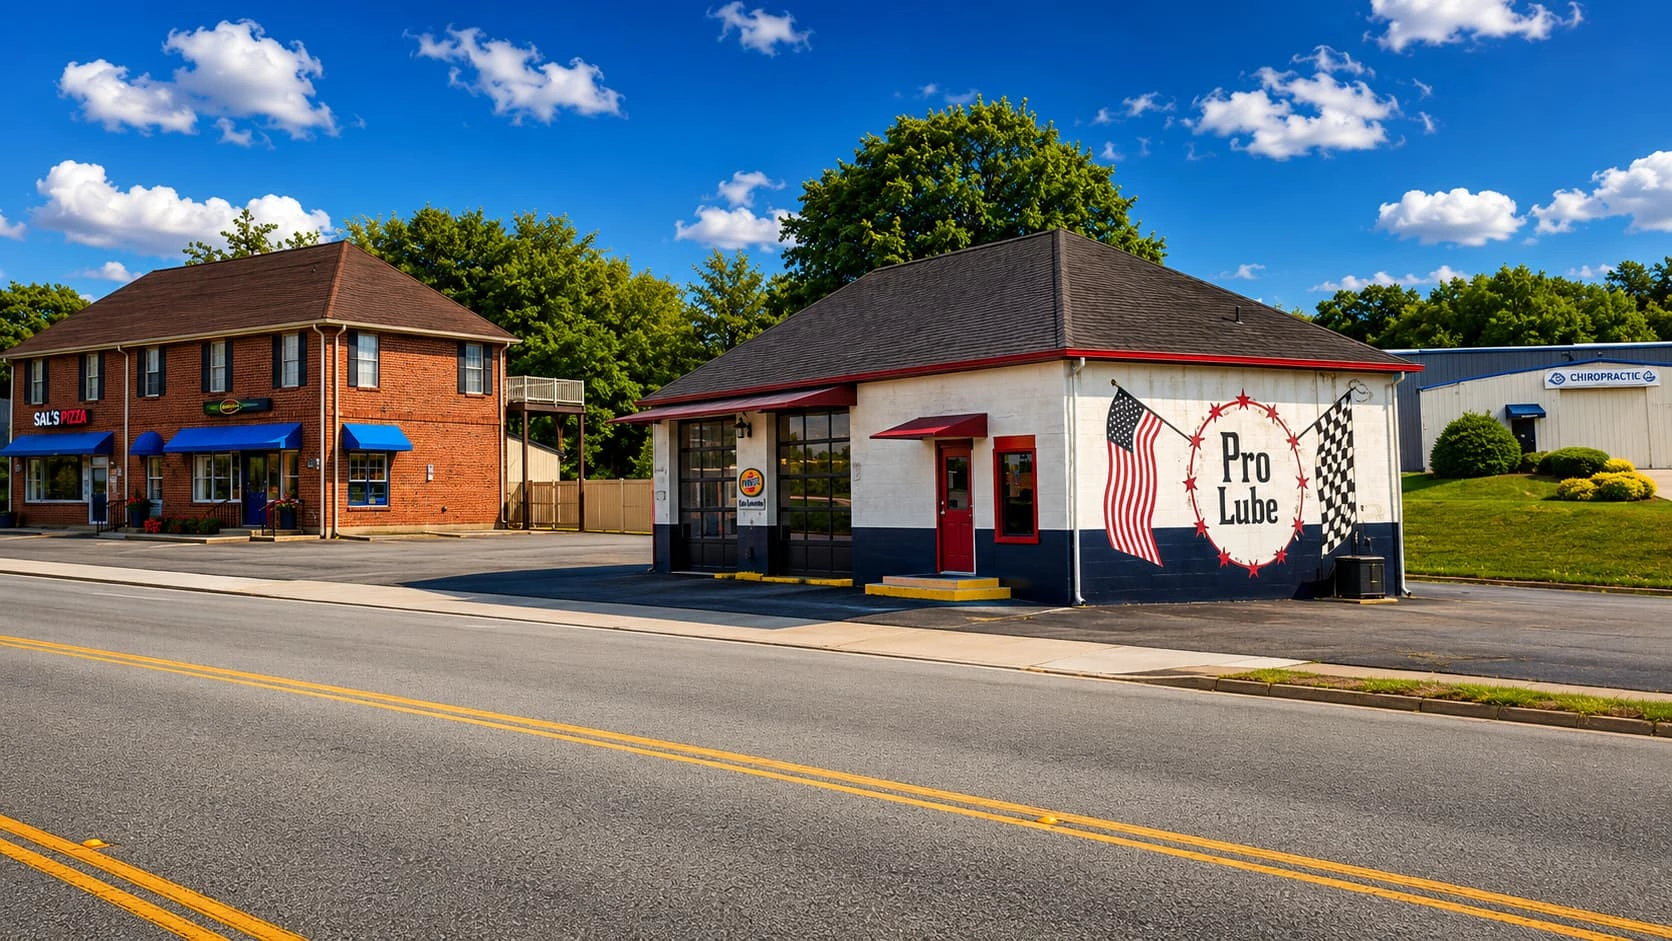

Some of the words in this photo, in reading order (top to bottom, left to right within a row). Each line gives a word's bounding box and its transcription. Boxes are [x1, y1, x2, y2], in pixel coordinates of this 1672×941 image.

[1570, 371, 1641, 382] CHIROPRACTIC
[34, 410, 60, 426] SAL'S
[61, 409, 87, 424] PIZZA
[1220, 432, 1271, 483] Pro
[1217, 486, 1278, 525] Lube
